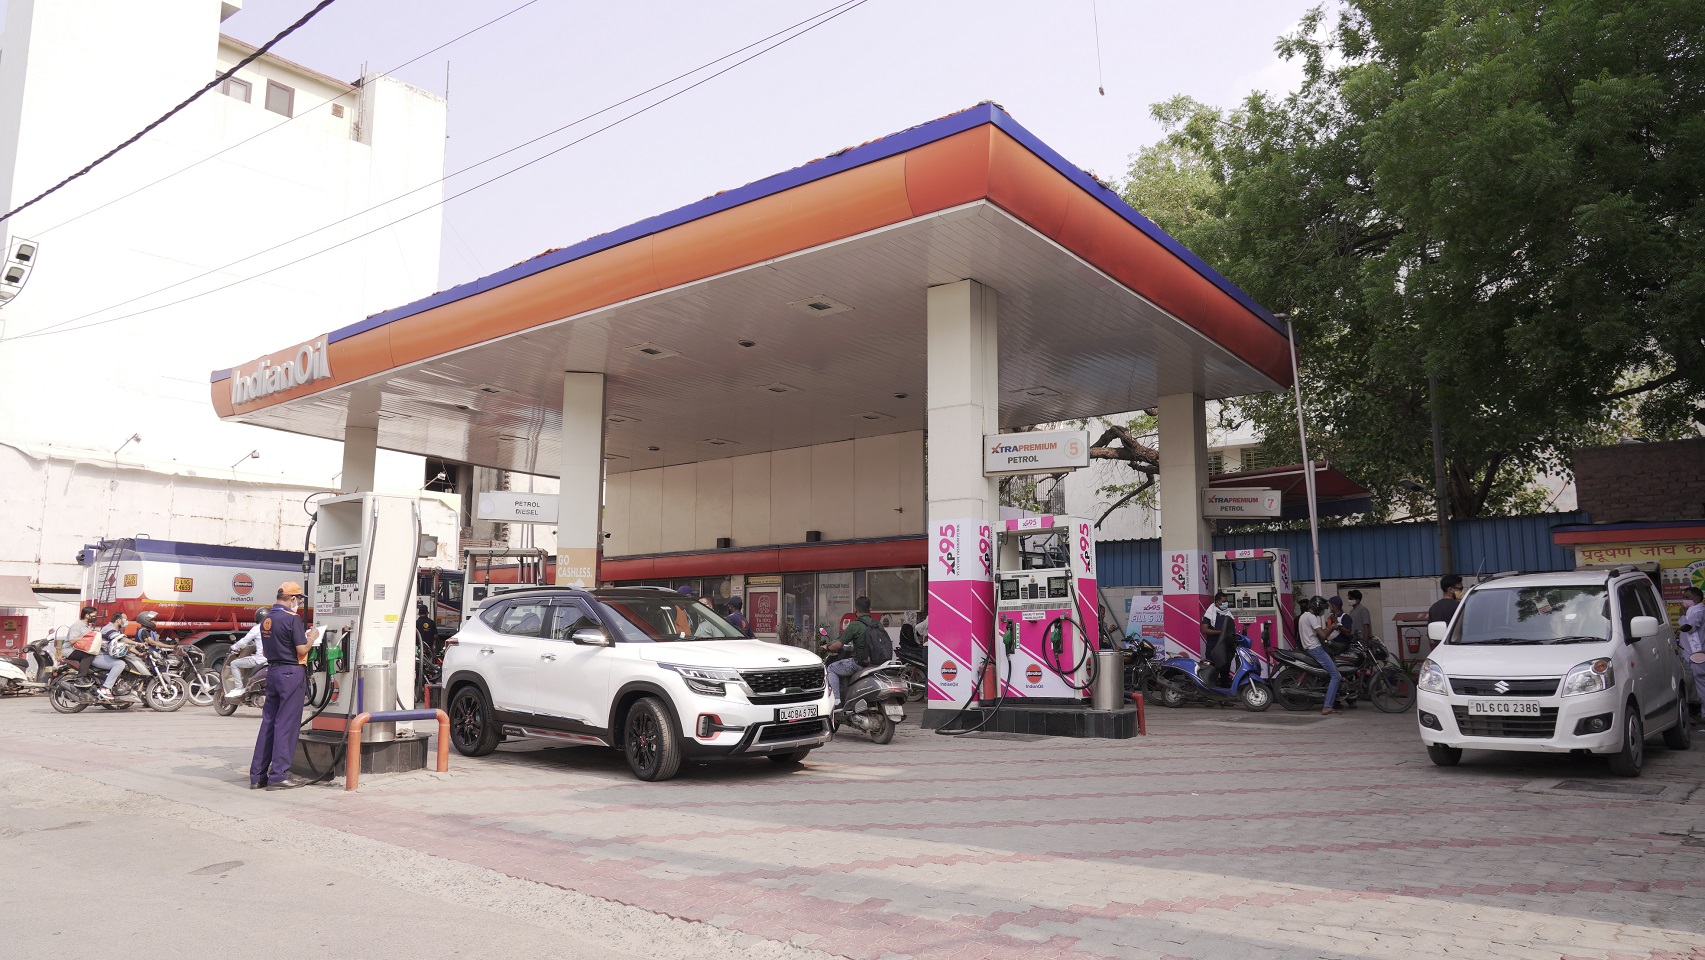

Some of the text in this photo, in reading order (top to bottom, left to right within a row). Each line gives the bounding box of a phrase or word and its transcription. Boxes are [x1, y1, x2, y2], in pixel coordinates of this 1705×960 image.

[231, 339, 331, 405] IndianOil
[991, 442, 1058, 454] XTRAPREMIUM
[1069, 442, 1079, 456] 5
[1007, 455, 1039, 464] PETROL
[1207, 495, 1259, 504] XTRAPREMIUM
[1267, 498, 1275, 509] 7
[938, 524, 956, 576] XP95
[979, 525, 991, 576] XP95
[1080, 523, 1090, 573] XP95
[558, 555, 570, 566] GO
[1581, 547, 1632, 563] प्रदूषण
[558, 567, 593, 578] CASHLESS.
[1171, 553, 1185, 591] XP95
[1406, 638, 1420, 646] FIRE
